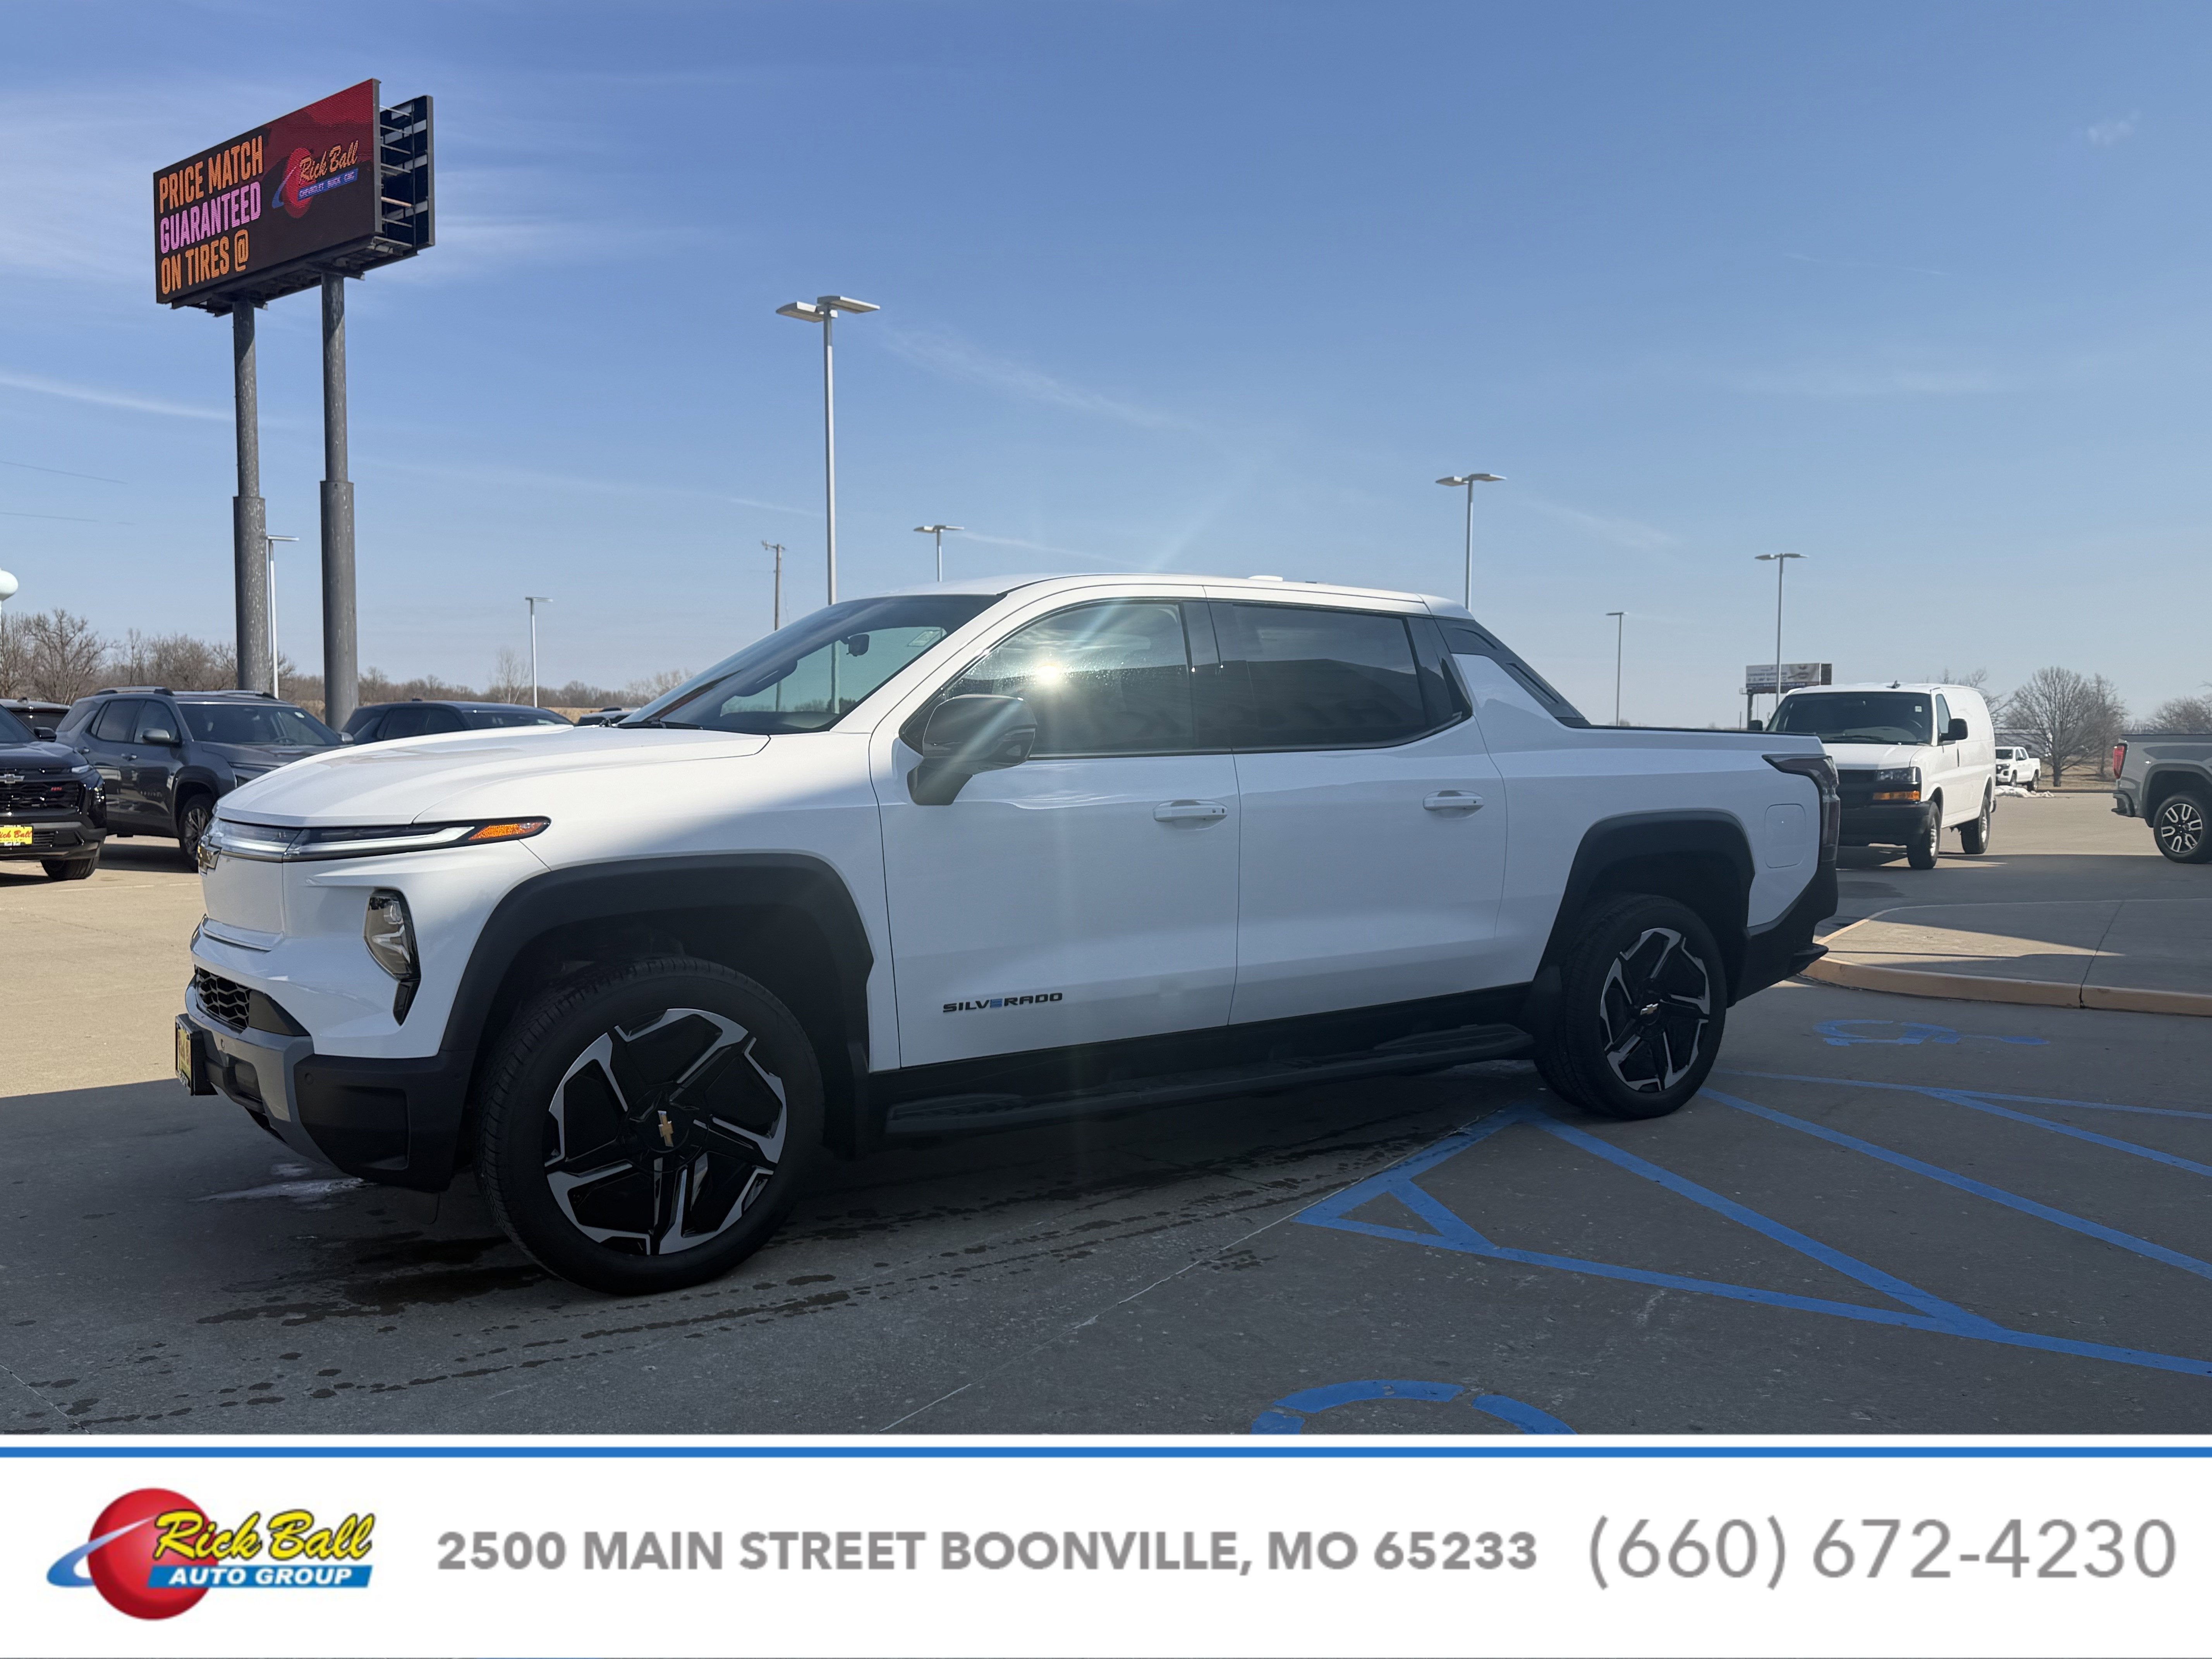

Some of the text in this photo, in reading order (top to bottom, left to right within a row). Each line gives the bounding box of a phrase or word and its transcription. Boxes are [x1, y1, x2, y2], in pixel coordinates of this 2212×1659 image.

[160, 161, 204, 213] PRICE
[208, 135, 263, 194] MATCH
[299, 151, 327, 184] Rick
[329, 140, 358, 172] Ball
[160, 181, 261, 254] GUARANTEED
[161, 229, 249, 294] ON TIRES @
[14, 830, 32, 838] Ball
[943, 992, 1063, 1013] SILVERADO
